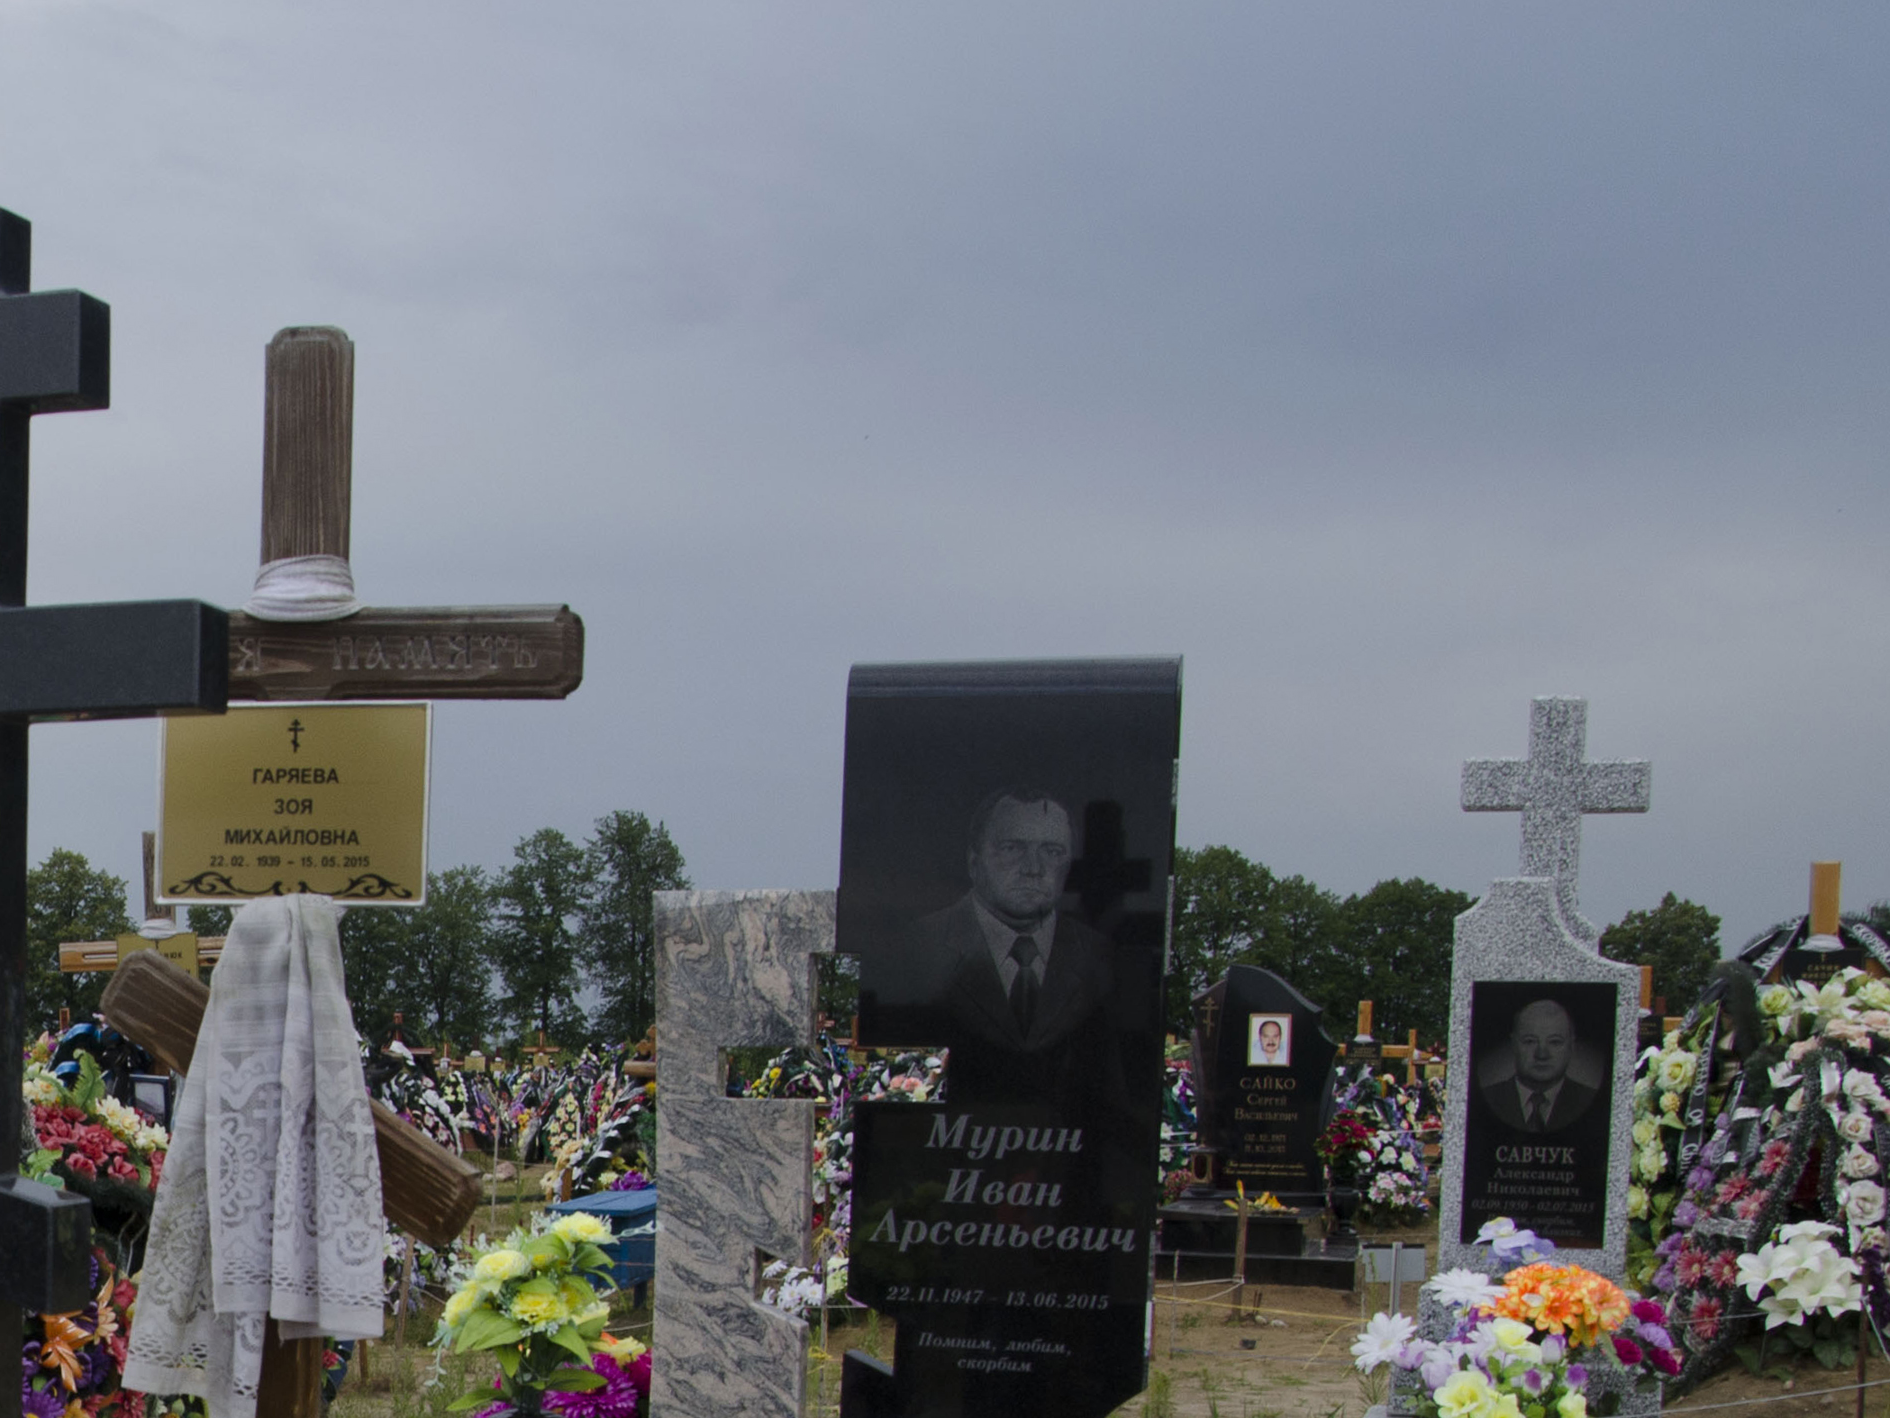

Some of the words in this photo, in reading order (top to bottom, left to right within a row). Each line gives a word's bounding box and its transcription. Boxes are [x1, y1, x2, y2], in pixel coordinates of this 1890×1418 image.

[251, 767, 340, 785] ГАРЯЕВА
[273, 798, 314, 816] ЗОЯ
[223, 825, 360, 846] МИХАЙЛОВНА
[1239, 1074, 1297, 1091] САЙКО
[924, 1112, 1084, 1161] Мурин
[1495, 1145, 1577, 1165] САВЧУК
[1493, 1167, 1576, 1184] Александр
[942, 1167, 1063, 1208] Иван
[1486, 1181, 1582, 1198] Николаевич
[868, 1207, 1137, 1253] Арсеньевич
[885, 1286, 985, 1305] 22.11.1947
[1004, 1290, 1110, 1311] 13.06.2015
[917, 1331, 998, 1353] Помним,
